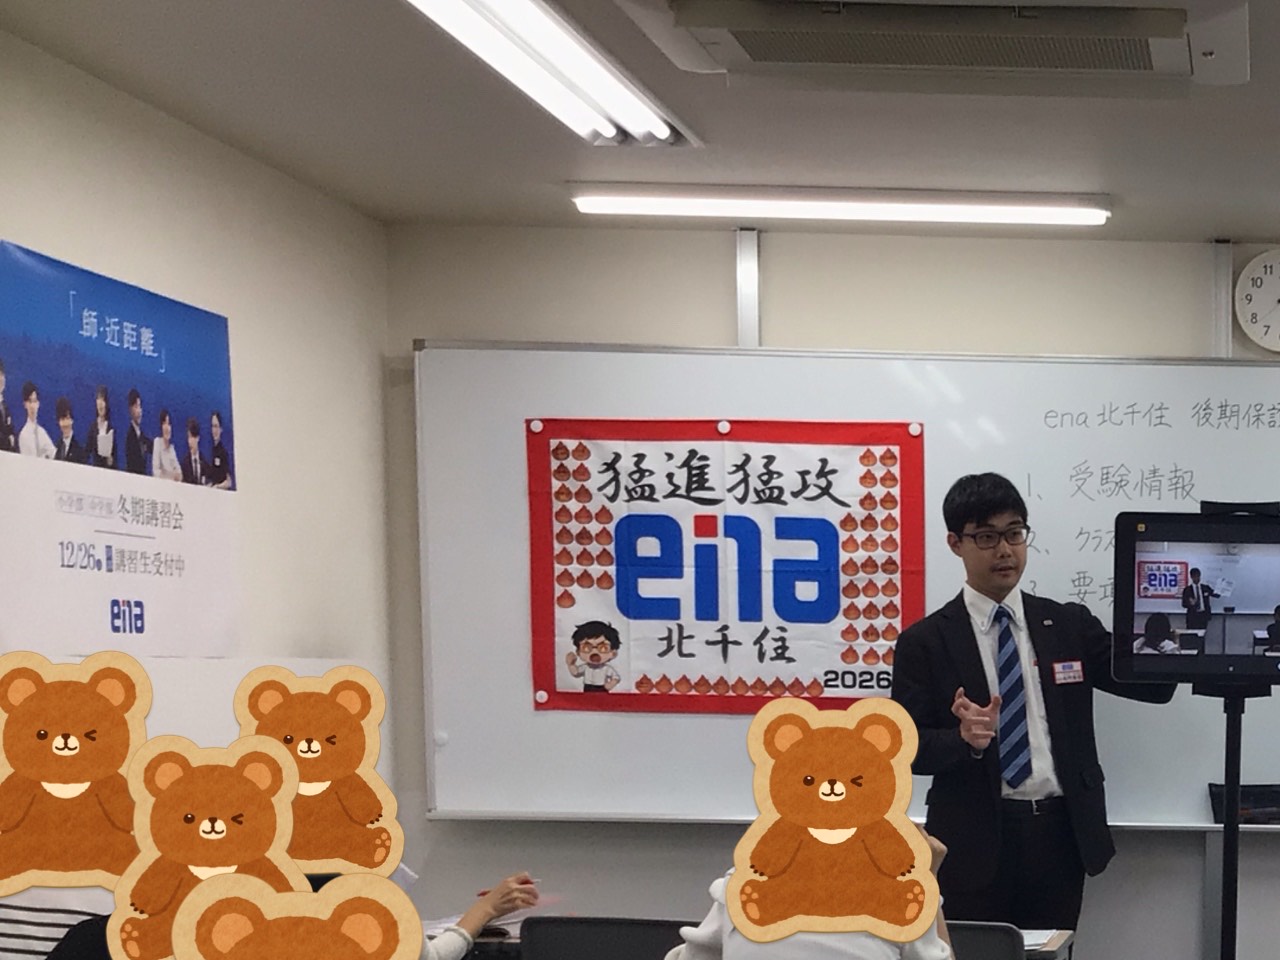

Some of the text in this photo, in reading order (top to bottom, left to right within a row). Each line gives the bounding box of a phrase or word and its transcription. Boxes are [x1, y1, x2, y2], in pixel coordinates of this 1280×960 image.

[1263, 264, 1273, 275] 11
[1251, 277, 1263, 288] 10
[1245, 294, 1253, 305] 9
[1250, 313, 1258, 324] 8
[1263, 325, 1271, 336] 7
[1097, 401, 1173, 429] 北千住
[597, 448, 852, 508] 猛進猛攻
[1069, 459, 1201, 503] 受験情報
[110, 598, 145, 634] ena
[657, 623, 797, 664] 北千住
[823, 670, 893, 690] 2026
